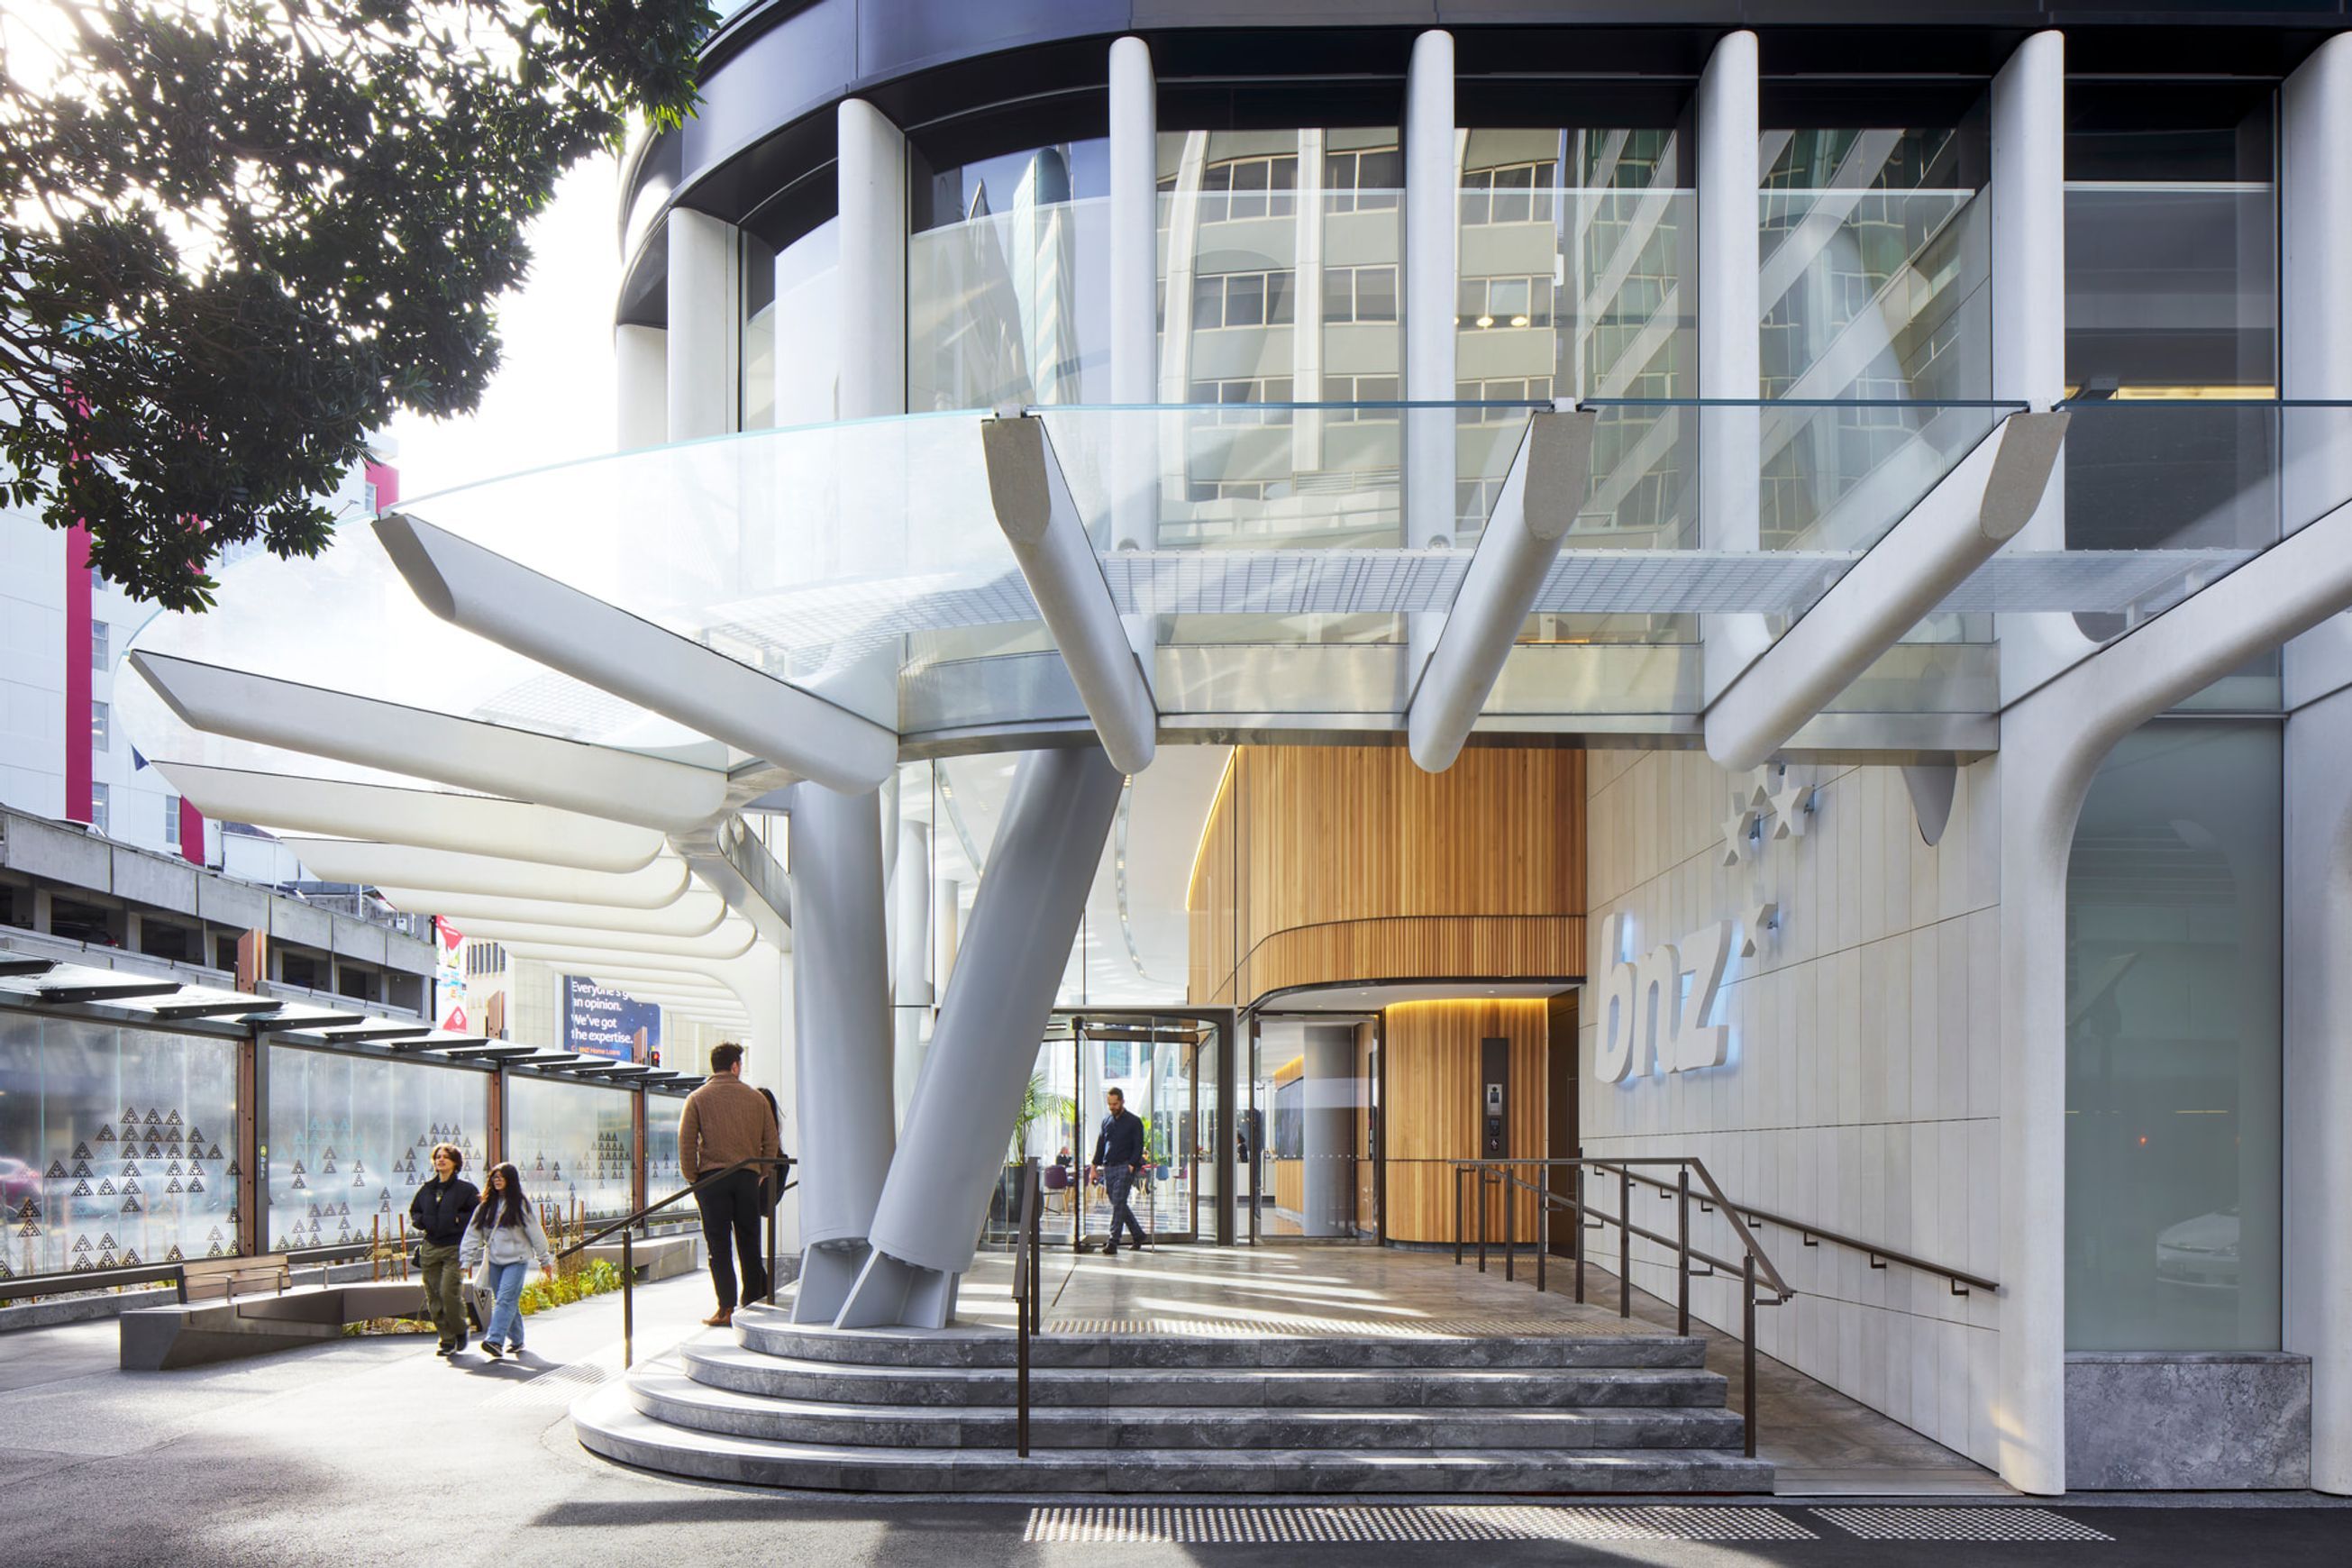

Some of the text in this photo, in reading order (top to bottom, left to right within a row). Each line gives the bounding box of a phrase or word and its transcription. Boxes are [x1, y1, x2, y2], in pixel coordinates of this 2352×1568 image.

[572, 998, 623, 1011] an opinion.
[1595, 913, 1731, 1083] bnz
[570, 1014, 617, 1030] We've got
[570, 1028, 634, 1044] the expertise.
